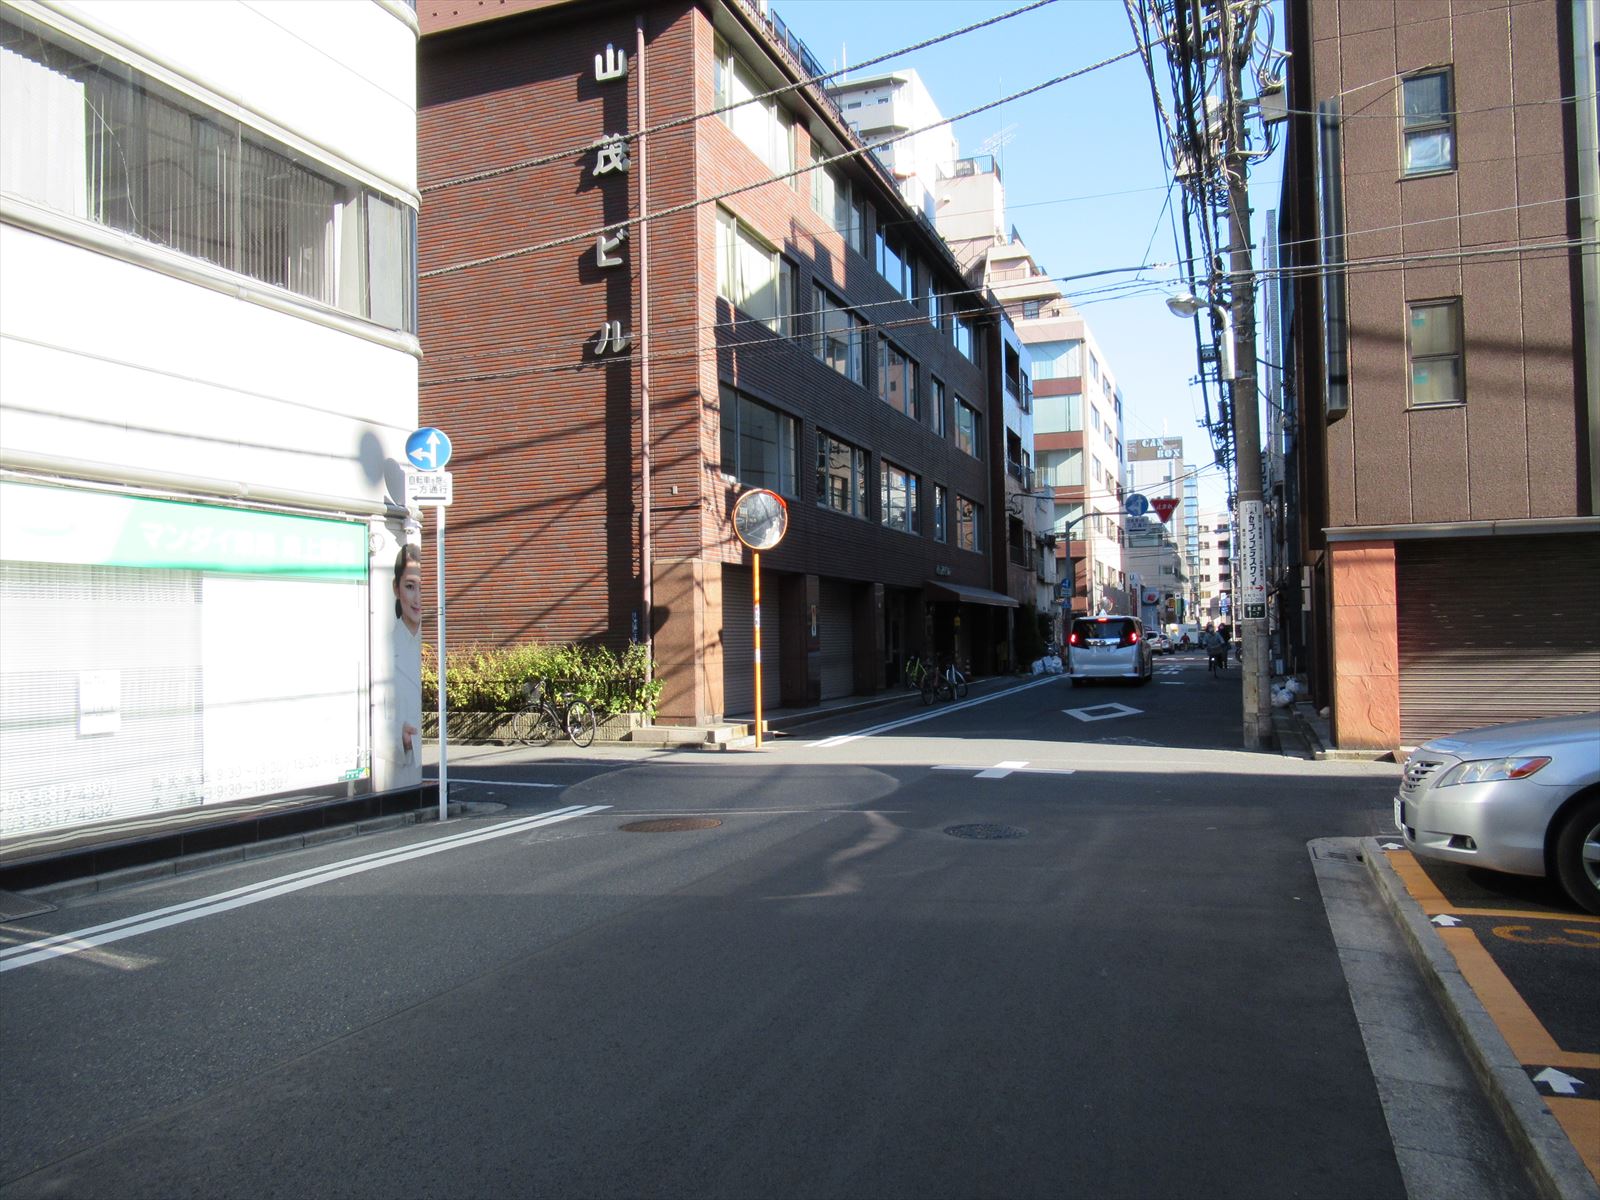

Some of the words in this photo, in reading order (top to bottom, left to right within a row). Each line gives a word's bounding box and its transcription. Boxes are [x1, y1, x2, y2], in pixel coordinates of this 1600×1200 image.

[593, 43, 630, 355] 山茂ビル
[409, 485, 448, 494] 一方通行
